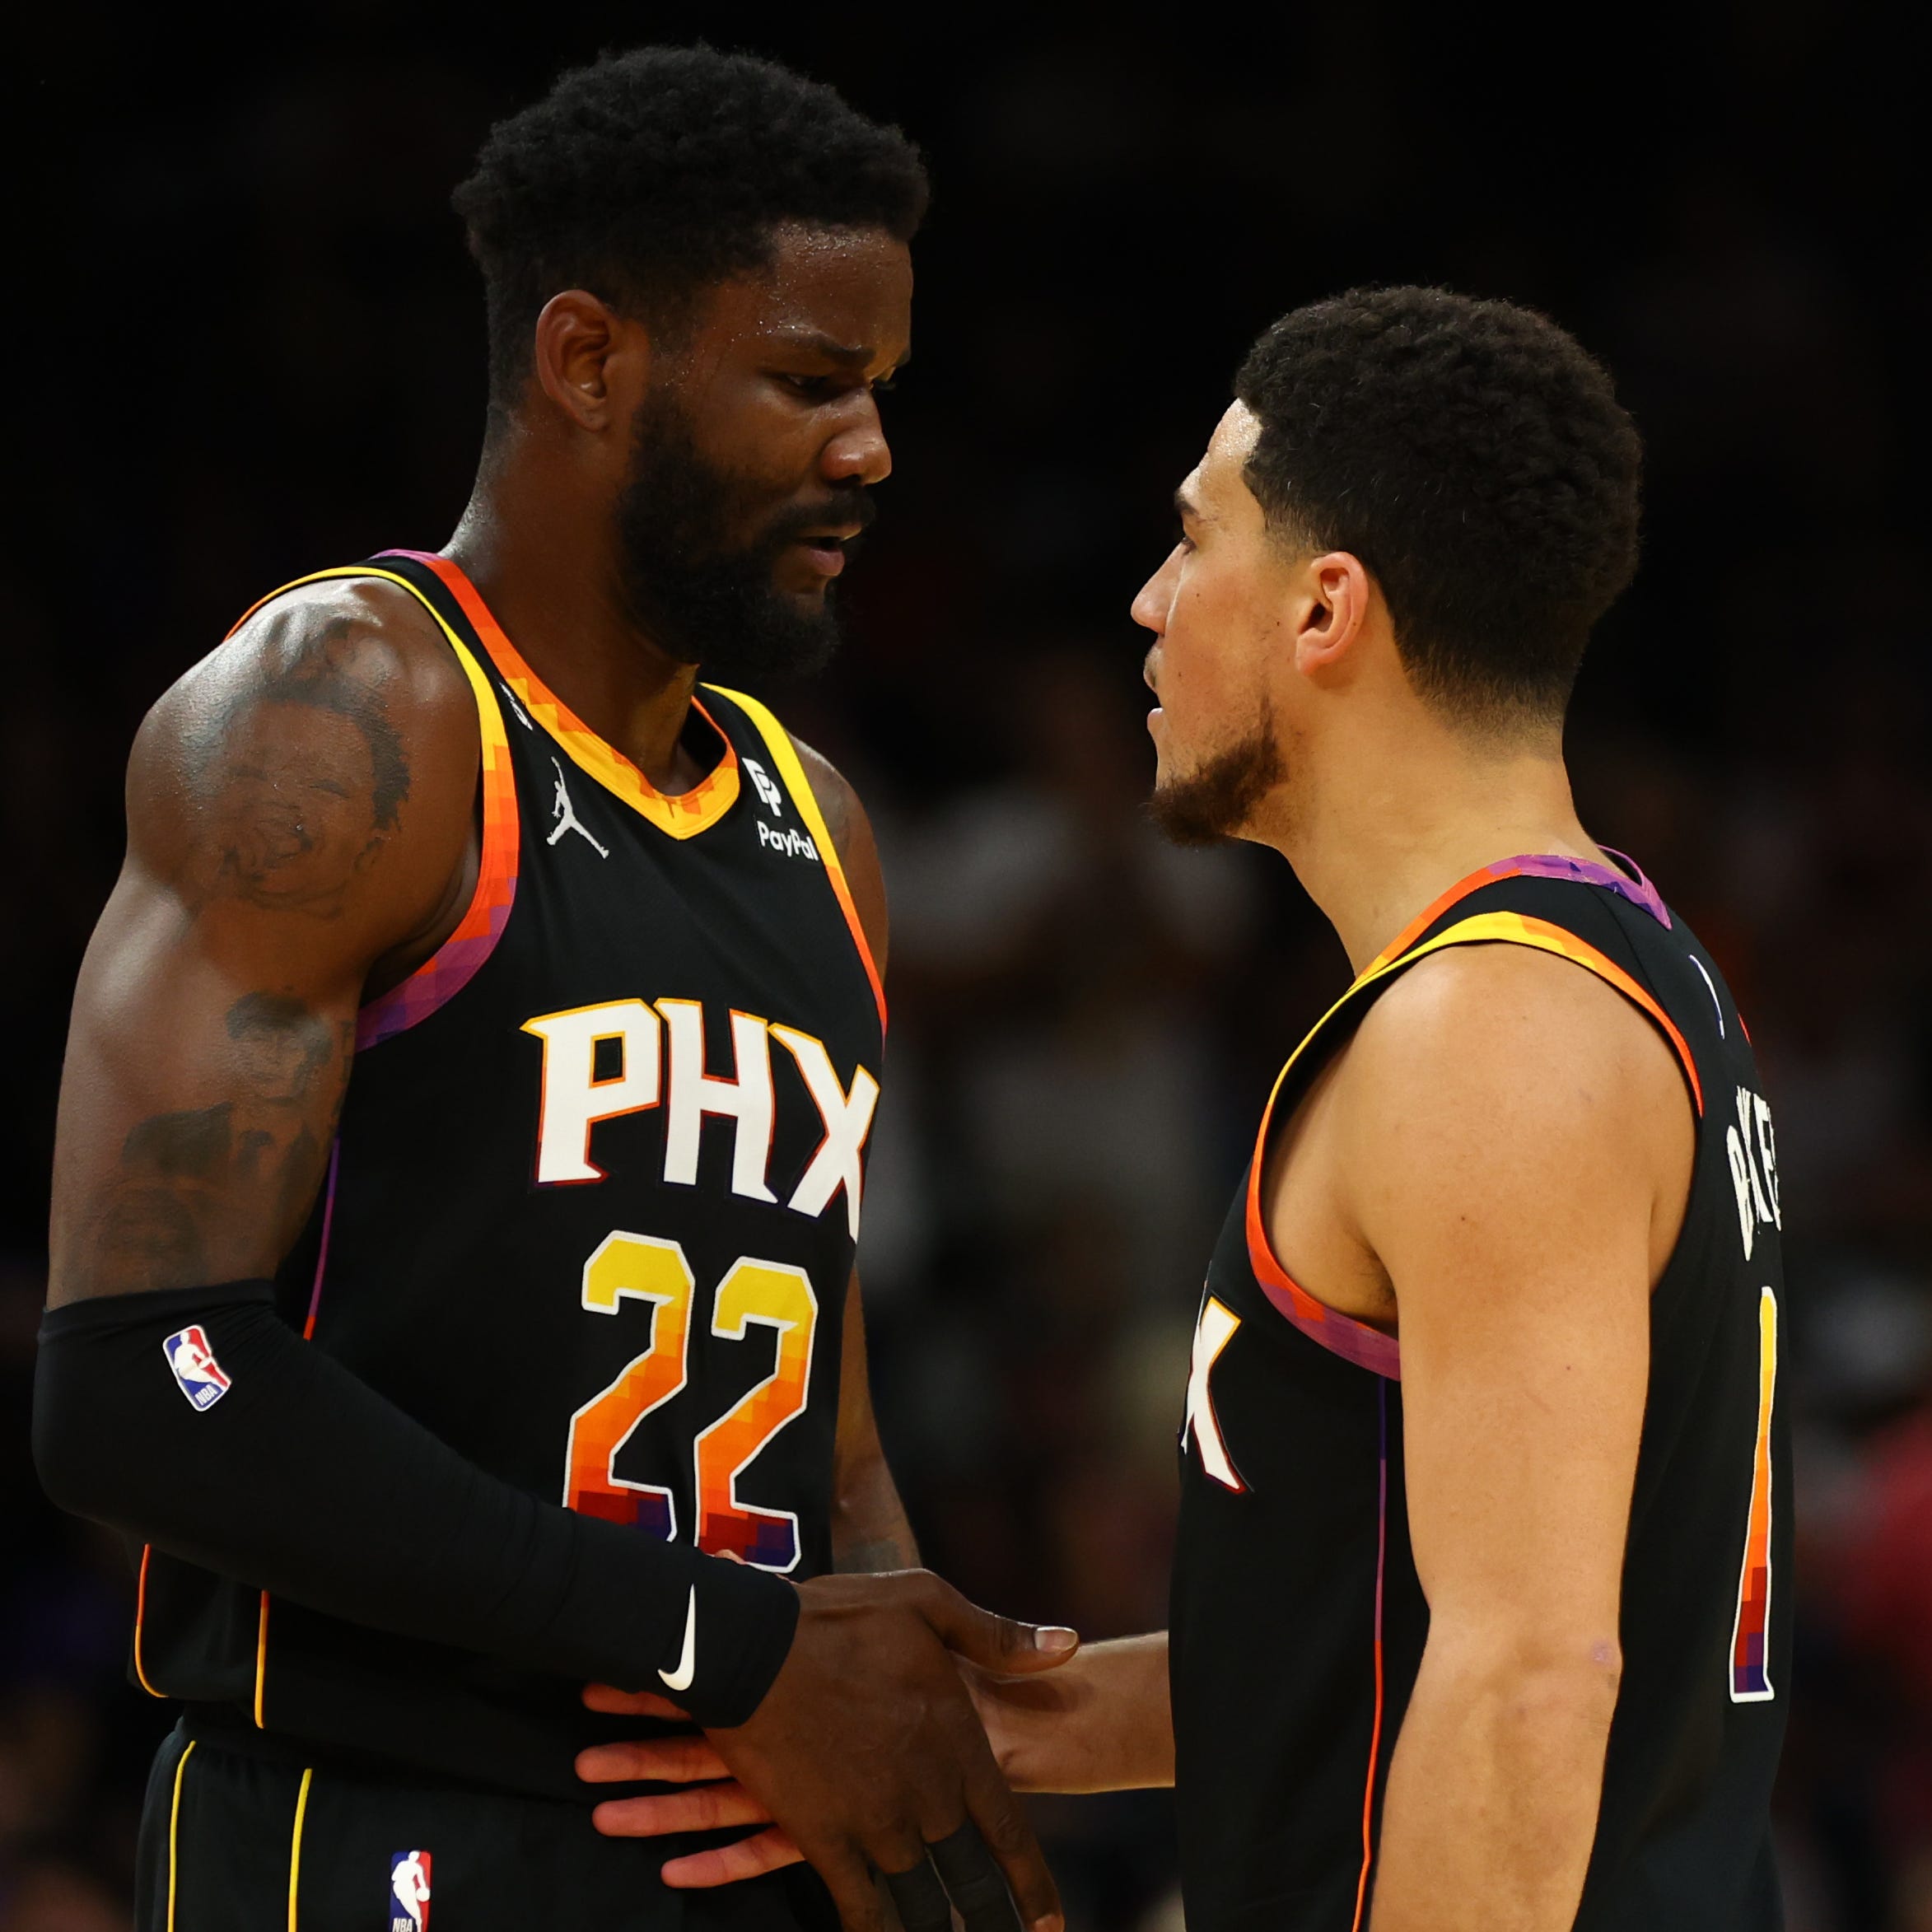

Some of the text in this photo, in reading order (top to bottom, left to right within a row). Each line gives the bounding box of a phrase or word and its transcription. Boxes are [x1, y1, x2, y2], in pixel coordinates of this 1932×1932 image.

[757, 820, 819, 861] PayPal
[520, 997, 880, 1244] PHX
[194, 1384, 218, 1406] NBA
[562, 1230, 819, 1574] 22
[1730, 1286, 1776, 1703] 1
[391, 1917, 413, 1932] NBA
